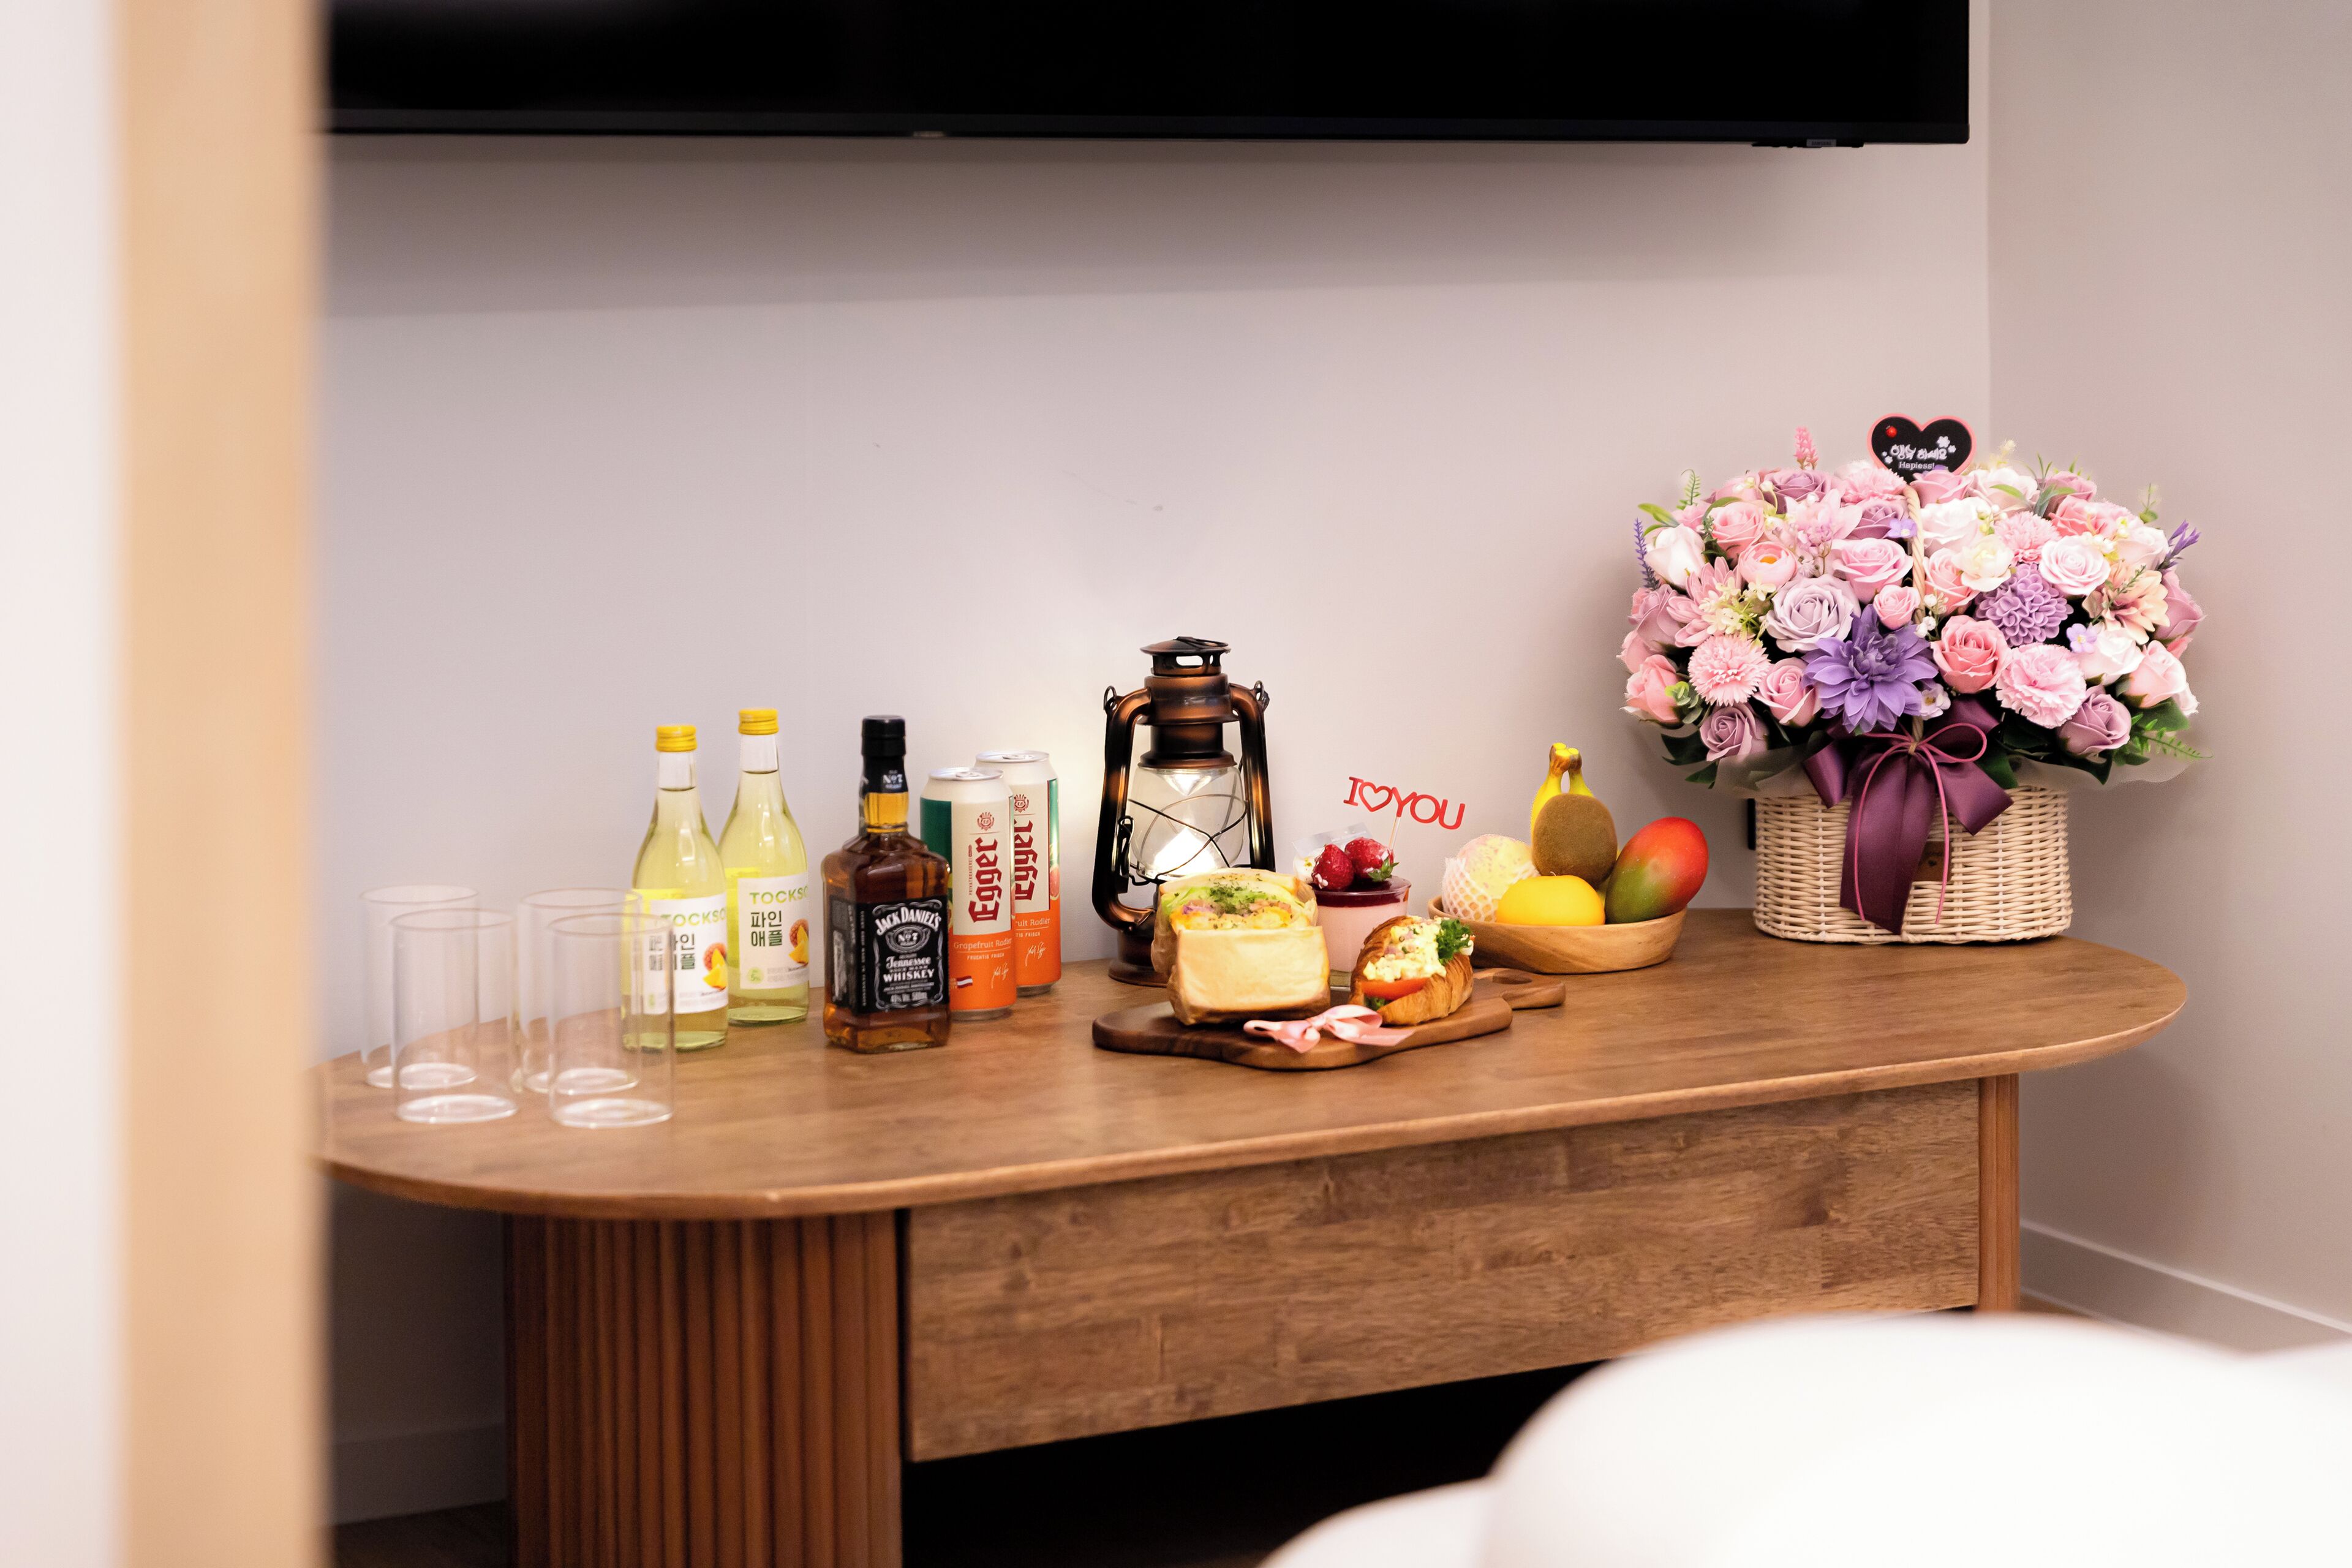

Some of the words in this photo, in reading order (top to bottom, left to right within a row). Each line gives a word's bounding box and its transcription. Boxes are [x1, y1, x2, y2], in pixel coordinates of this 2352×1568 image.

[1343, 776, 1364, 807] I
[1392, 786, 1466, 830] YOU
[968, 837, 1002, 923] Egger
[750, 910, 782, 927] 파인
[875, 911, 902, 936] JACK
[900, 907, 942, 932] DANIEL'S
[1030, 918, 1050, 926] Radler
[751, 930, 783, 946] 애플
[953, 940, 994, 951] Grapefruit
[886, 956, 932, 969] Tennessee
[883, 968, 935, 983] WHISKEY
